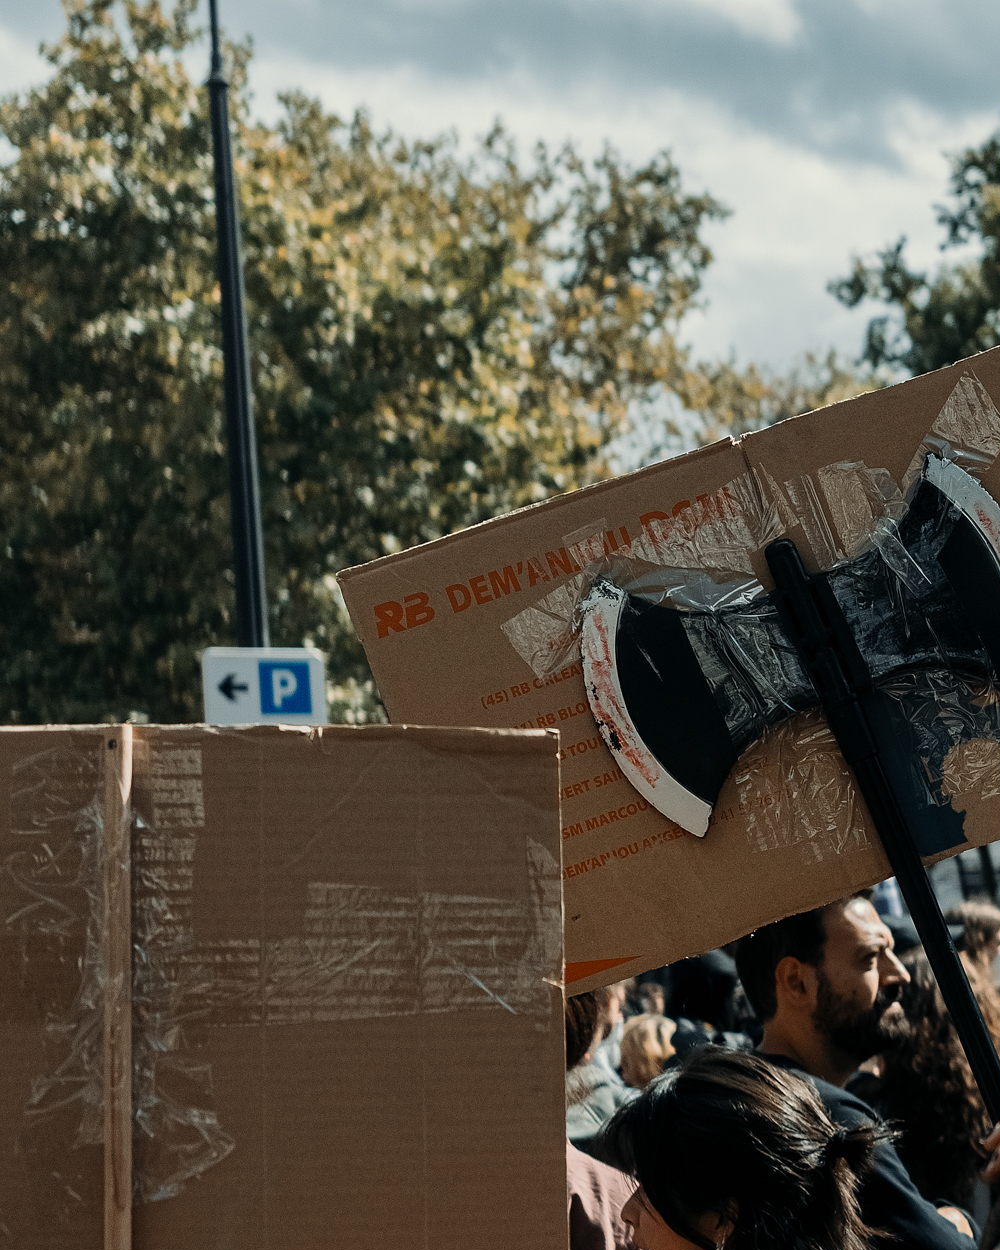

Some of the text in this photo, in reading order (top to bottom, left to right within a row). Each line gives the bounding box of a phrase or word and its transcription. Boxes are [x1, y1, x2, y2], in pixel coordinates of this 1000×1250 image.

[373, 591, 436, 639] RB
[271, 668, 298, 709] P
[480, 664, 583, 710] (45) RB ORLEA
[536, 712, 557, 728] RB
[558, 702, 590, 721] BLO
[562, 800, 651, 840] SM MARCOU
[720, 808, 735, 821] 41
